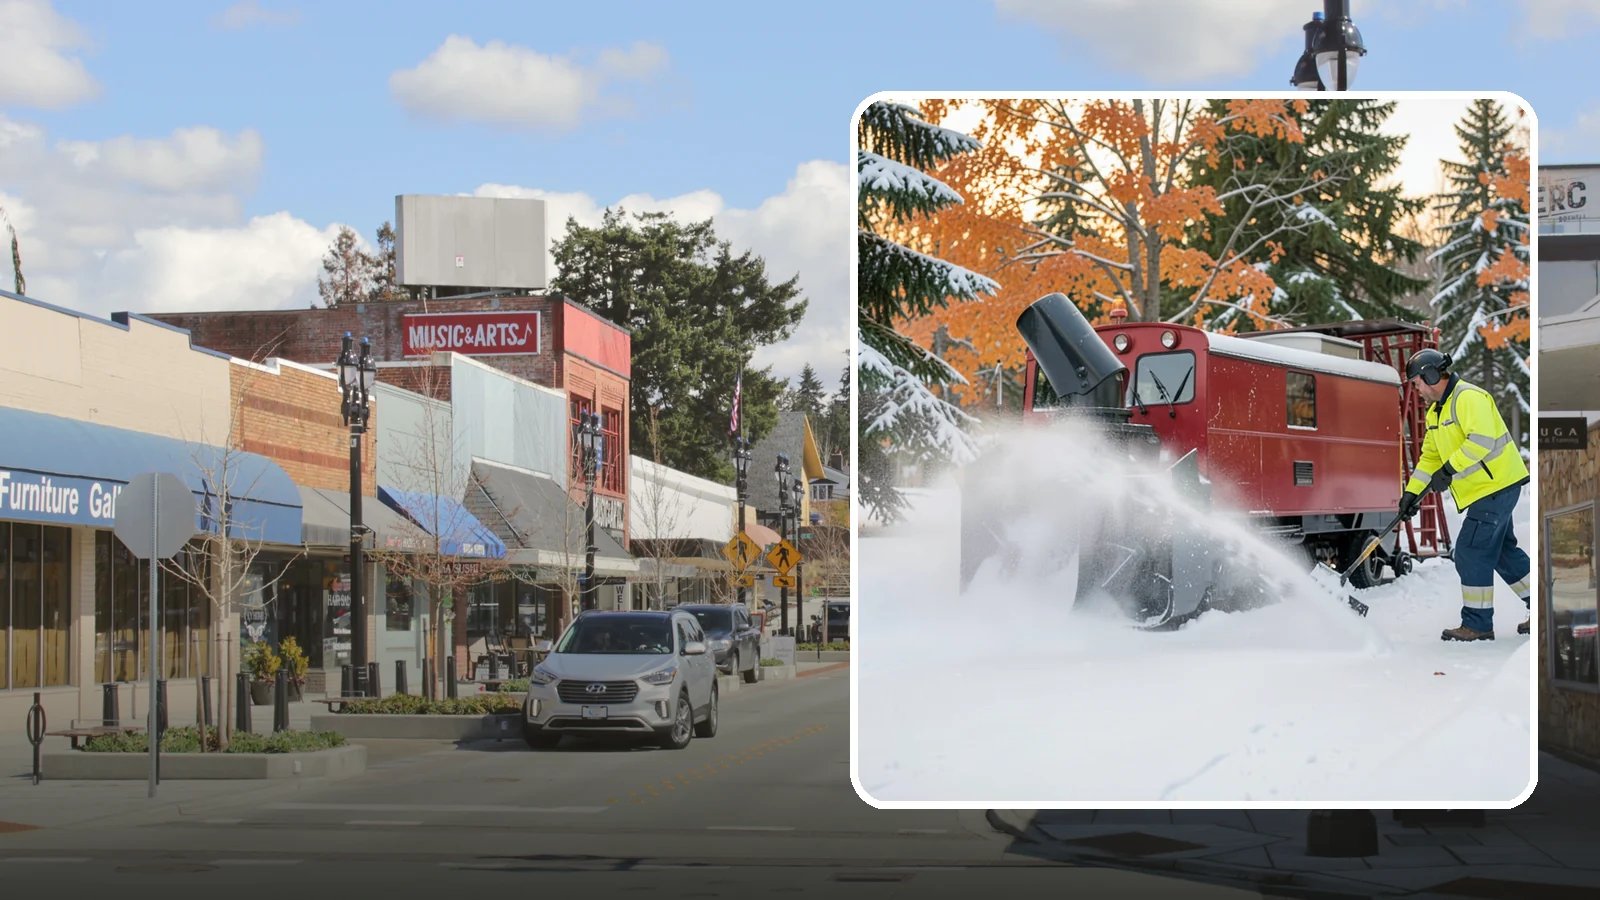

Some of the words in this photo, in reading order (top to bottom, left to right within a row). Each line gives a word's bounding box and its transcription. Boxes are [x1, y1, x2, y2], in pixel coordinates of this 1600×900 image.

[409, 323, 519, 349] MUSIC&ARTS
[1540, 427, 1577, 436] UGA
[0, 471, 79, 515] Furniture
[90, 482, 121, 519] Gal
[453, 563, 479, 574] SUSHI
